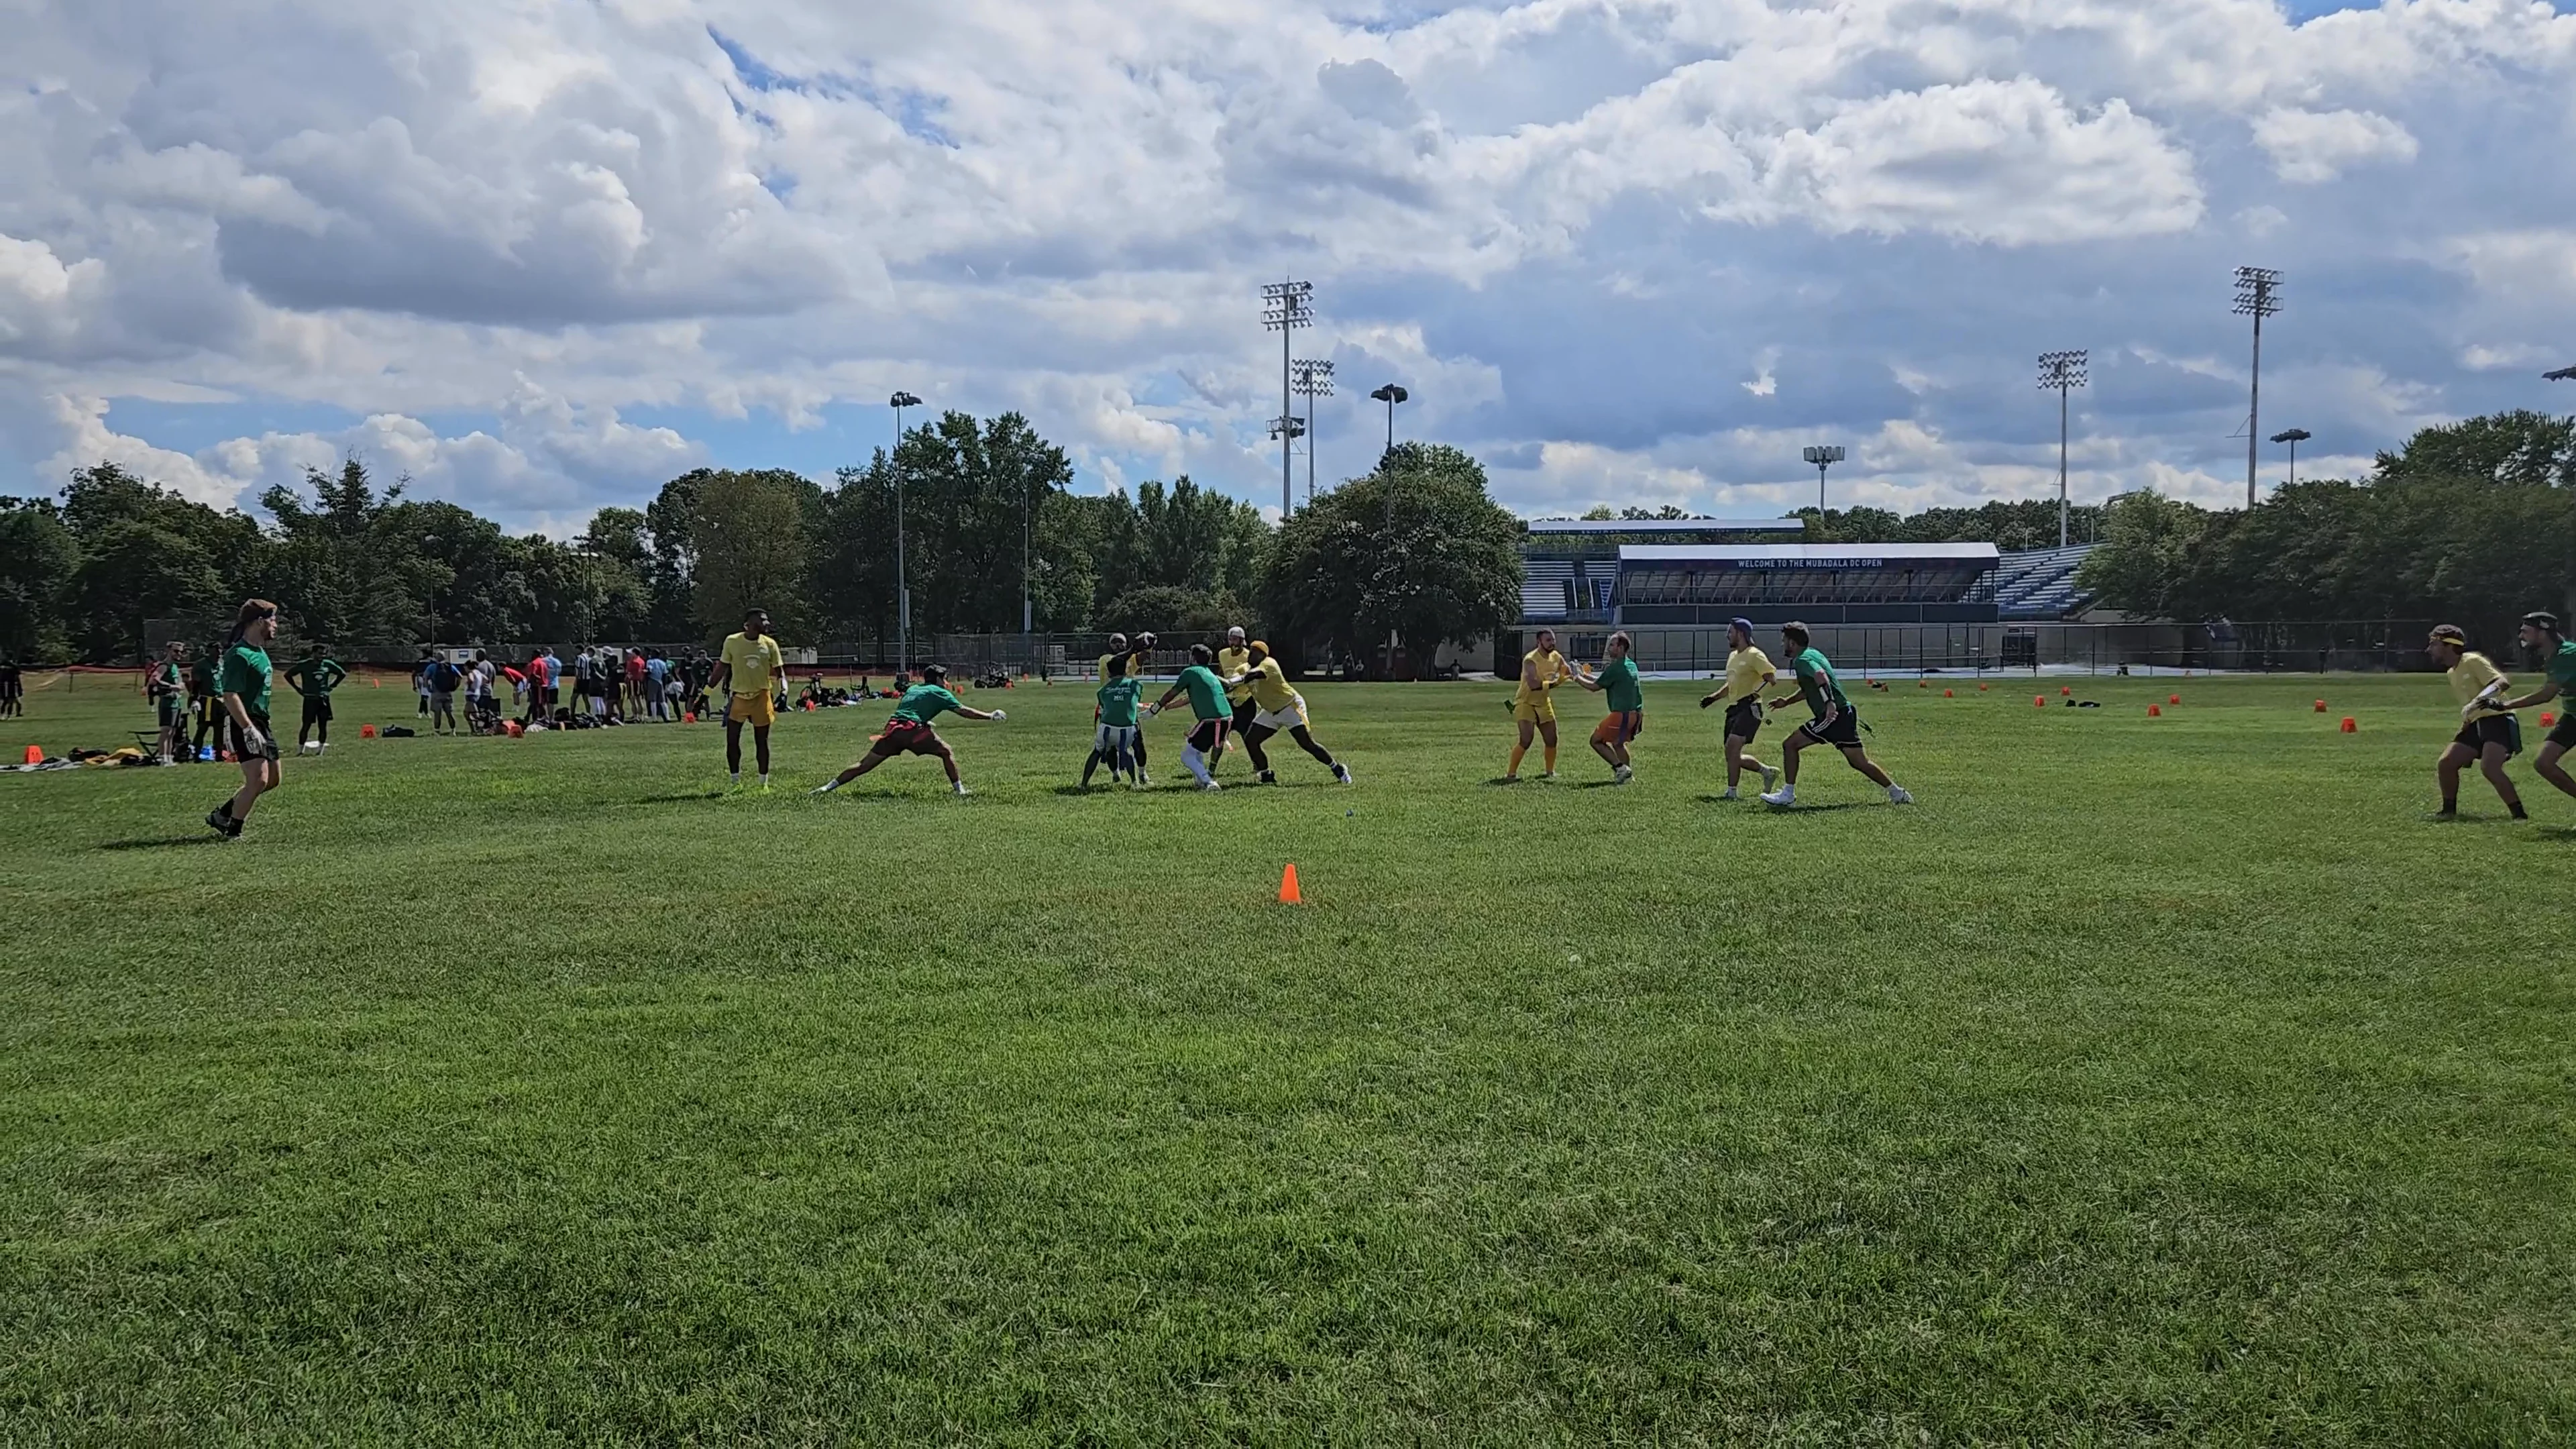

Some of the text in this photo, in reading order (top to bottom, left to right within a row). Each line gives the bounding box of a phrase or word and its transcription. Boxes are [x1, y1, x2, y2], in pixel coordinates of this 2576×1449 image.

[1738, 559, 1882, 568] WELCOME TO THE MUBADALA DC OPEN
